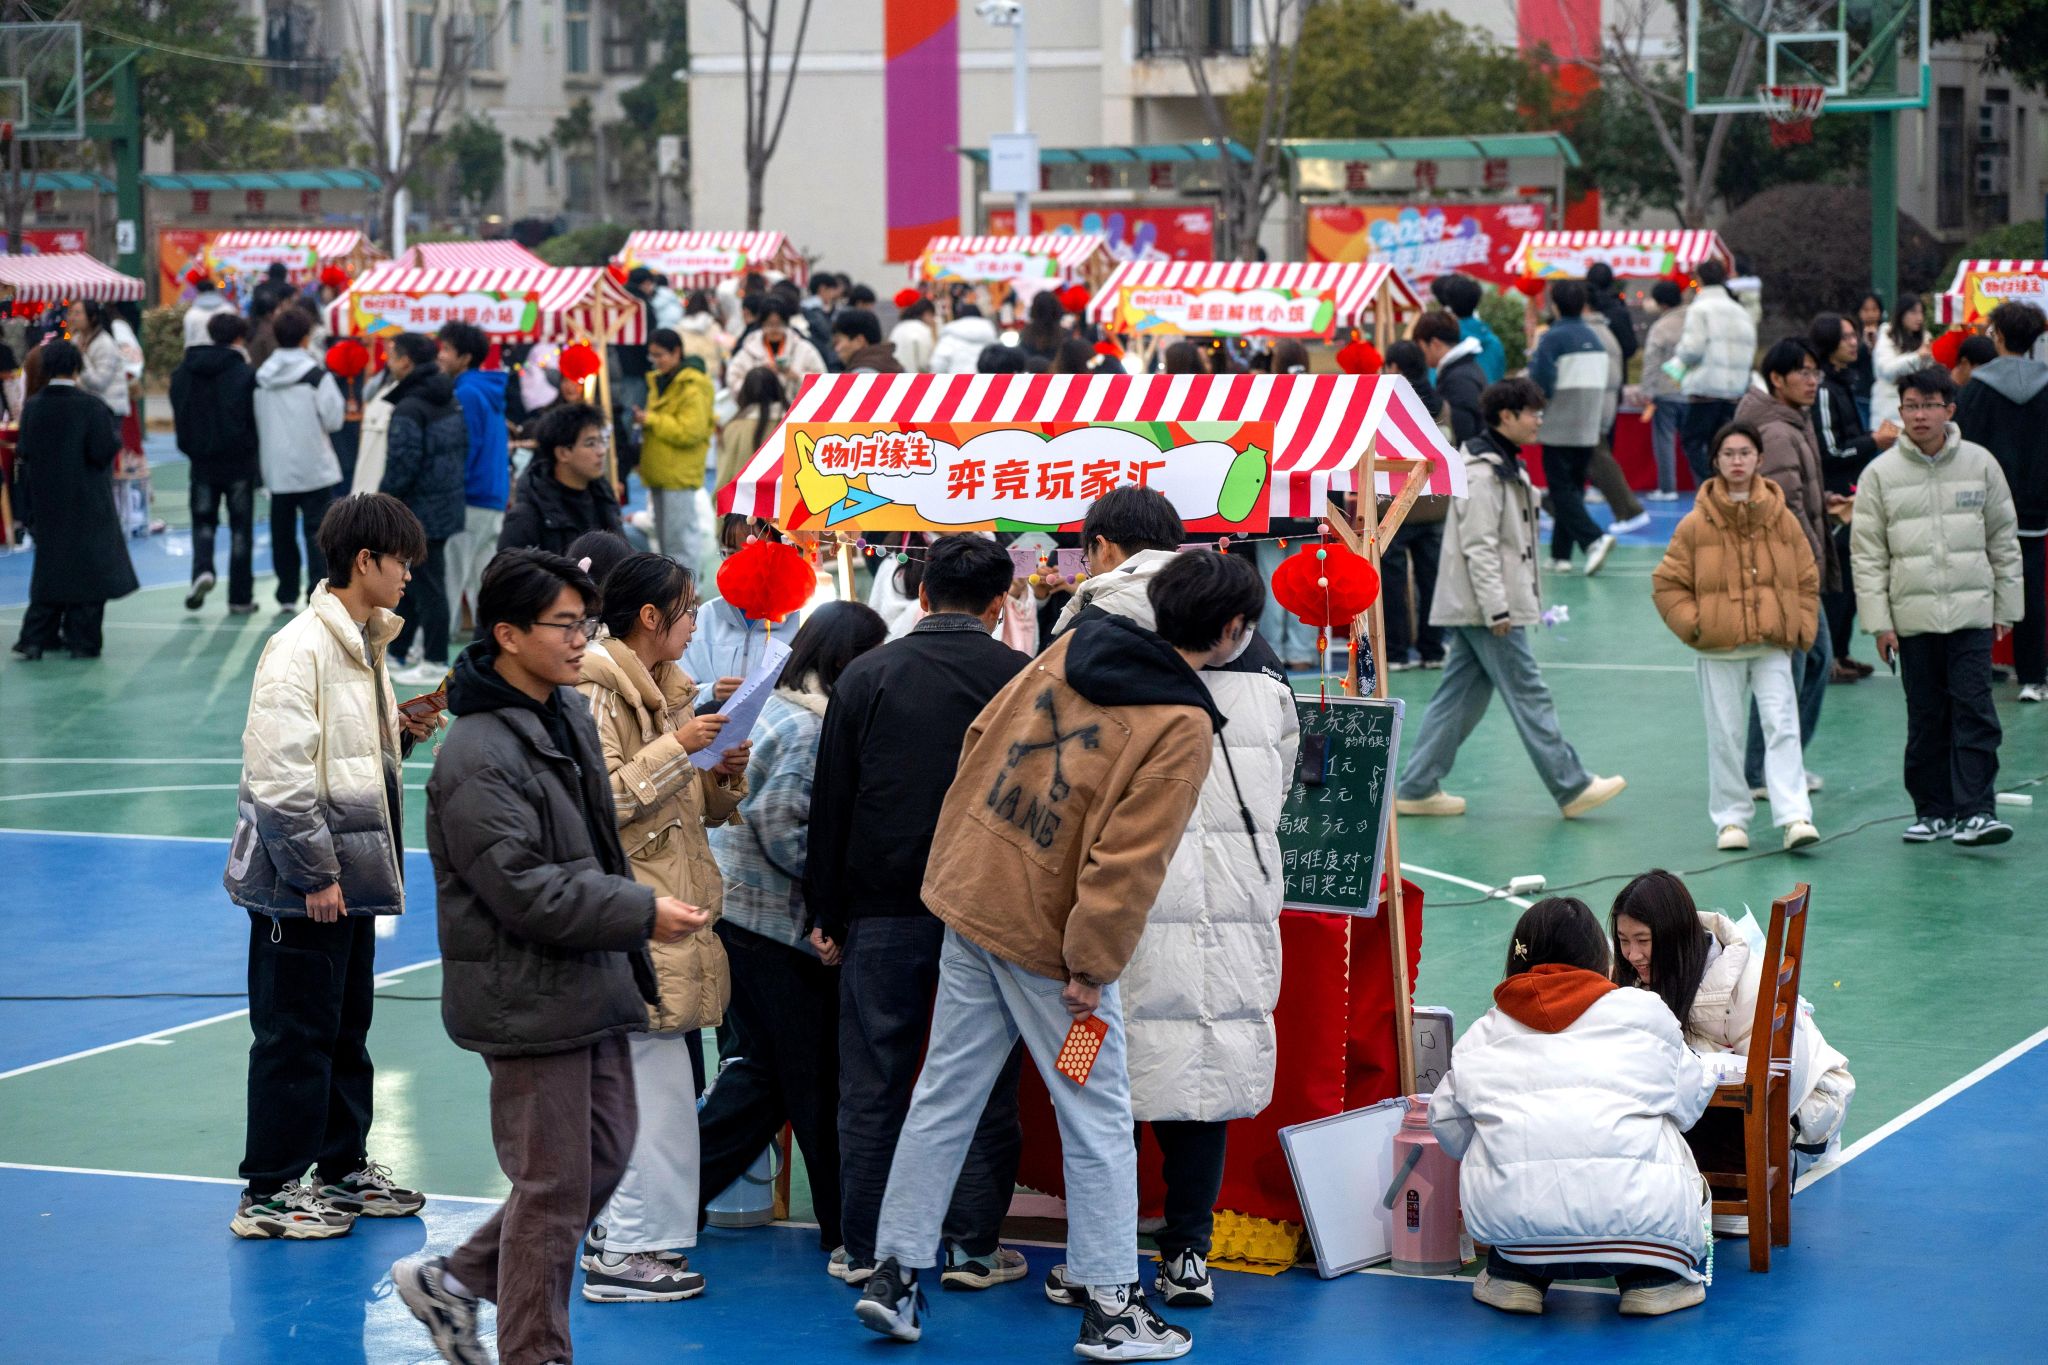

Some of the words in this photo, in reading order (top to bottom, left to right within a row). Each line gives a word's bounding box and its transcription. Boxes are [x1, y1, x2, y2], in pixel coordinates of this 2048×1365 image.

[946, 459, 1166, 500] 弈竞玩家汇
[1298, 707, 1385, 736] 竞玩家汇
